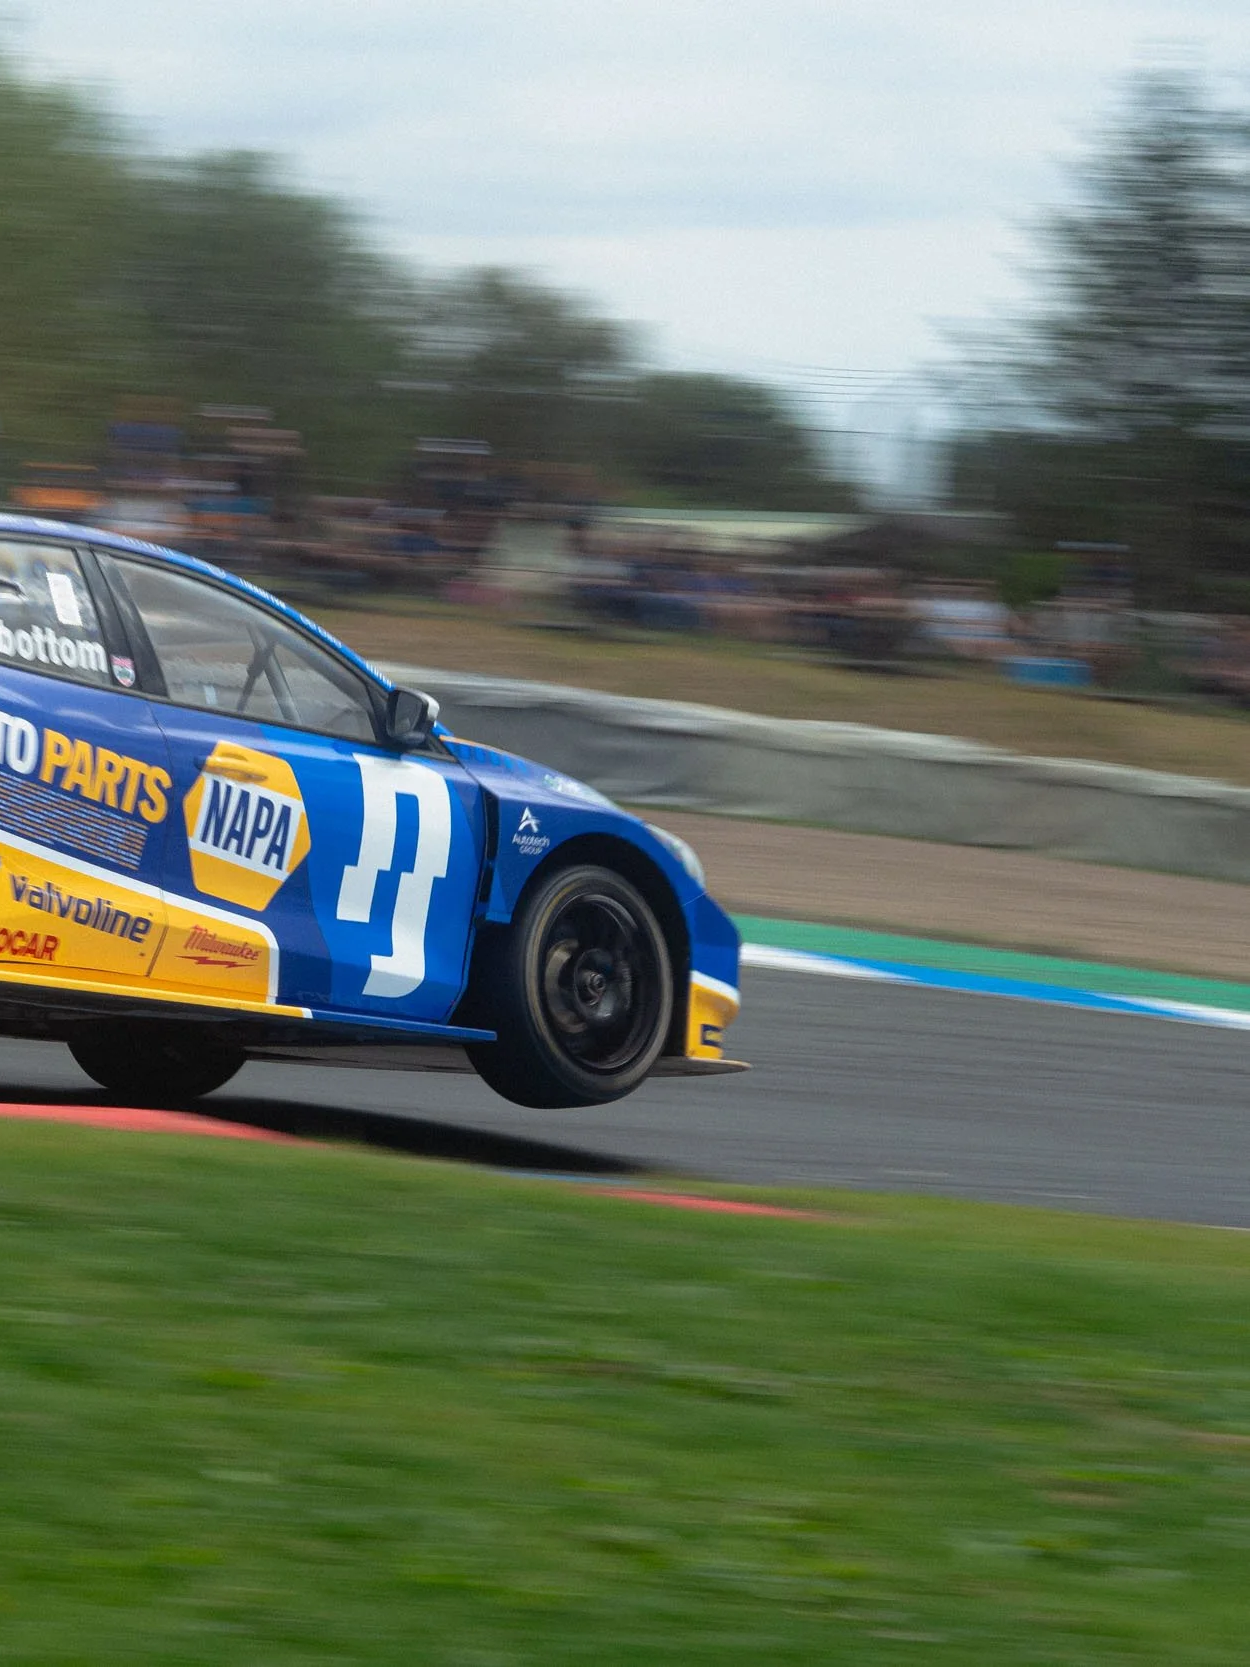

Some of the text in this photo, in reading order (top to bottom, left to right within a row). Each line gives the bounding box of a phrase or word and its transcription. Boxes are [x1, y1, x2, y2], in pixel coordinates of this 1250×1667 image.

[39, 728, 173, 824] PARTS
[200, 779, 293, 872] NAPA
[511, 832, 550, 848] Autotech
[10, 873, 153, 944] Valvoline
[182, 924, 262, 961] Milwaukee
